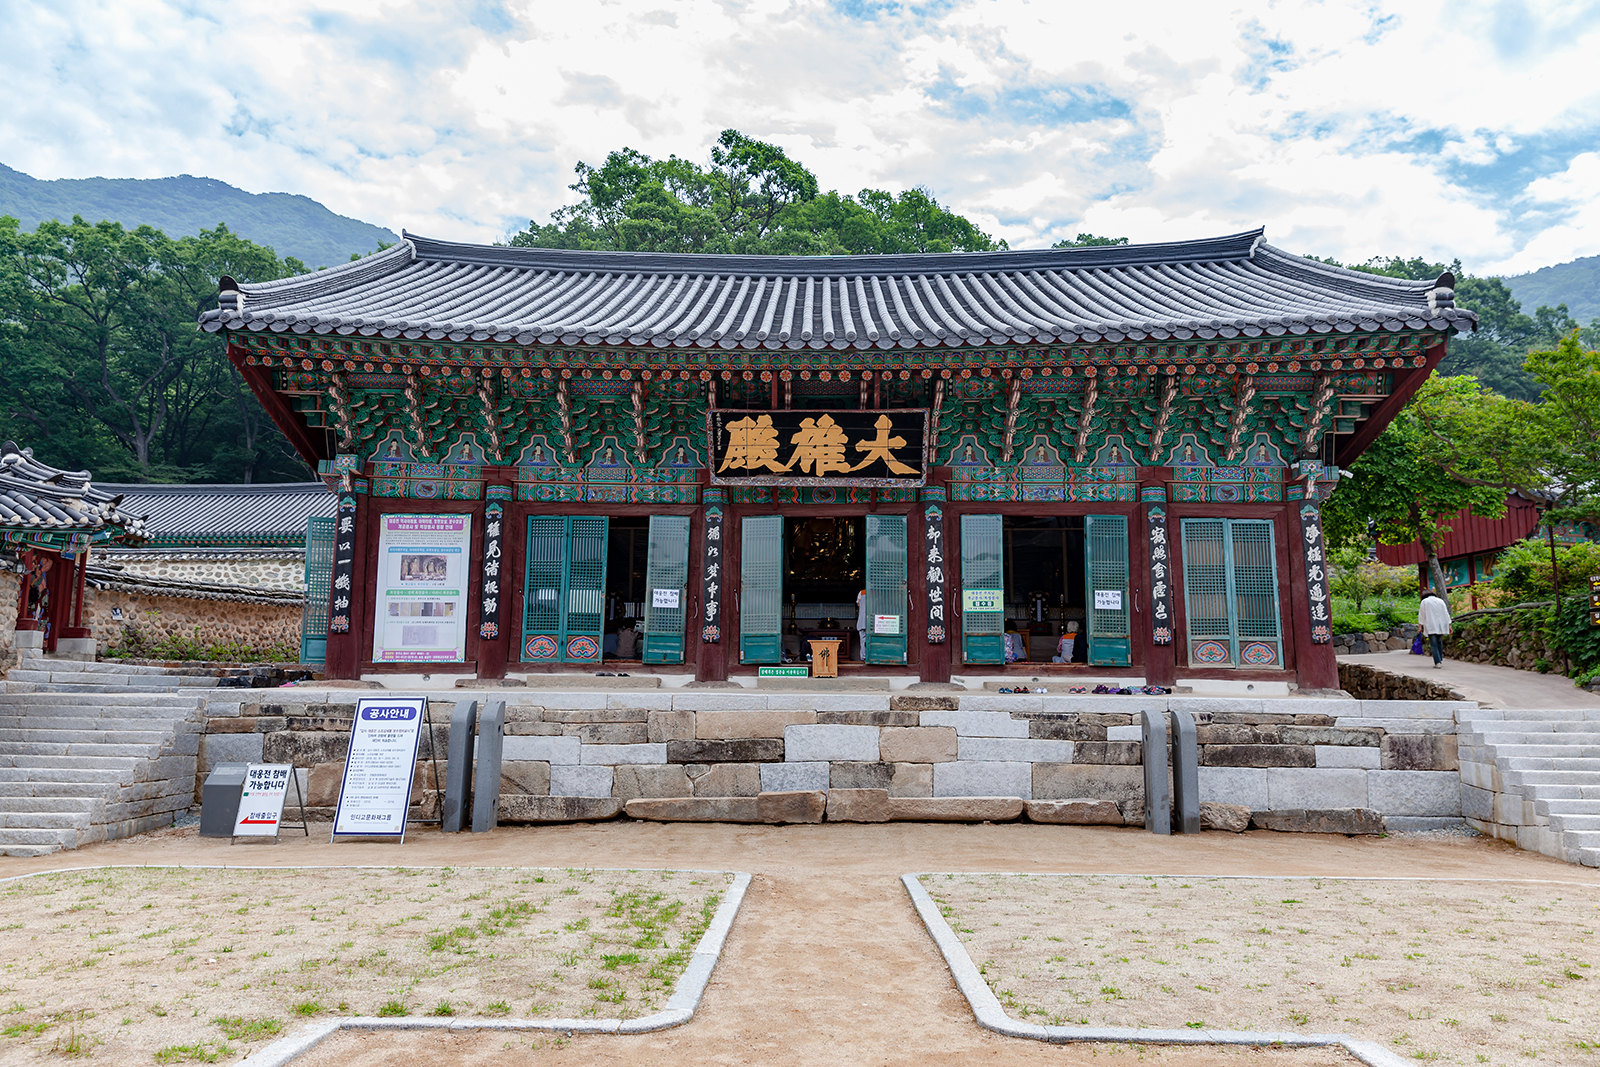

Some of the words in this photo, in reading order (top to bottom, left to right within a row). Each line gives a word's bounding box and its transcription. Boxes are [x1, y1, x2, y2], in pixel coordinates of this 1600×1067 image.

[717, 413, 921, 477] 大雄殿
[369, 708, 410, 719] 공사안내
[250, 769, 271, 779] 대웅전
[273, 769, 288, 779] 참배
[249, 780, 285, 790] 가능합니다
[249, 812, 277, 820] 참배출입구
